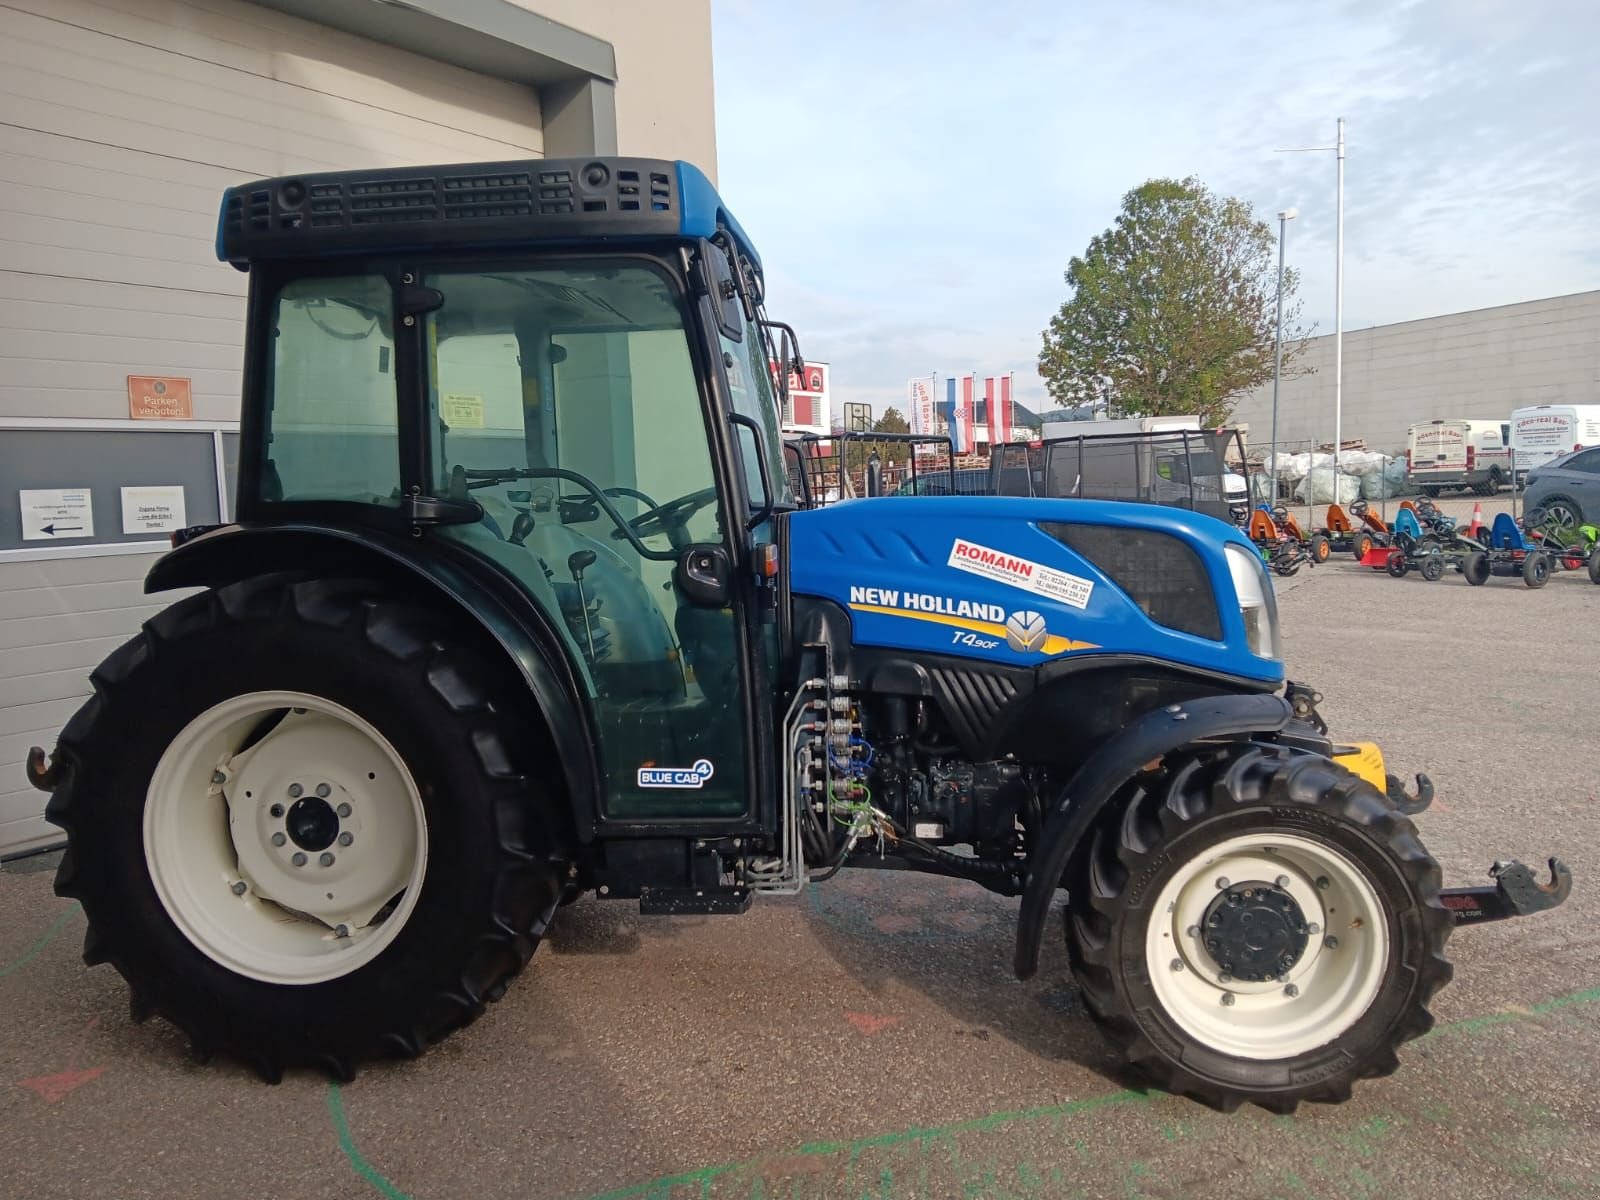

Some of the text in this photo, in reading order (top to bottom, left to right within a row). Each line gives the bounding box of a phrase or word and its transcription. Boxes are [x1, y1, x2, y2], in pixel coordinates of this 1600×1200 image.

[144, 396, 177, 405] Parken
[956, 543, 1033, 577] ROMANN
[850, 586, 899, 607] NEW
[904, 592, 1005, 623] HOLLAND
[641, 763, 709, 784] BLUE CAB 4
